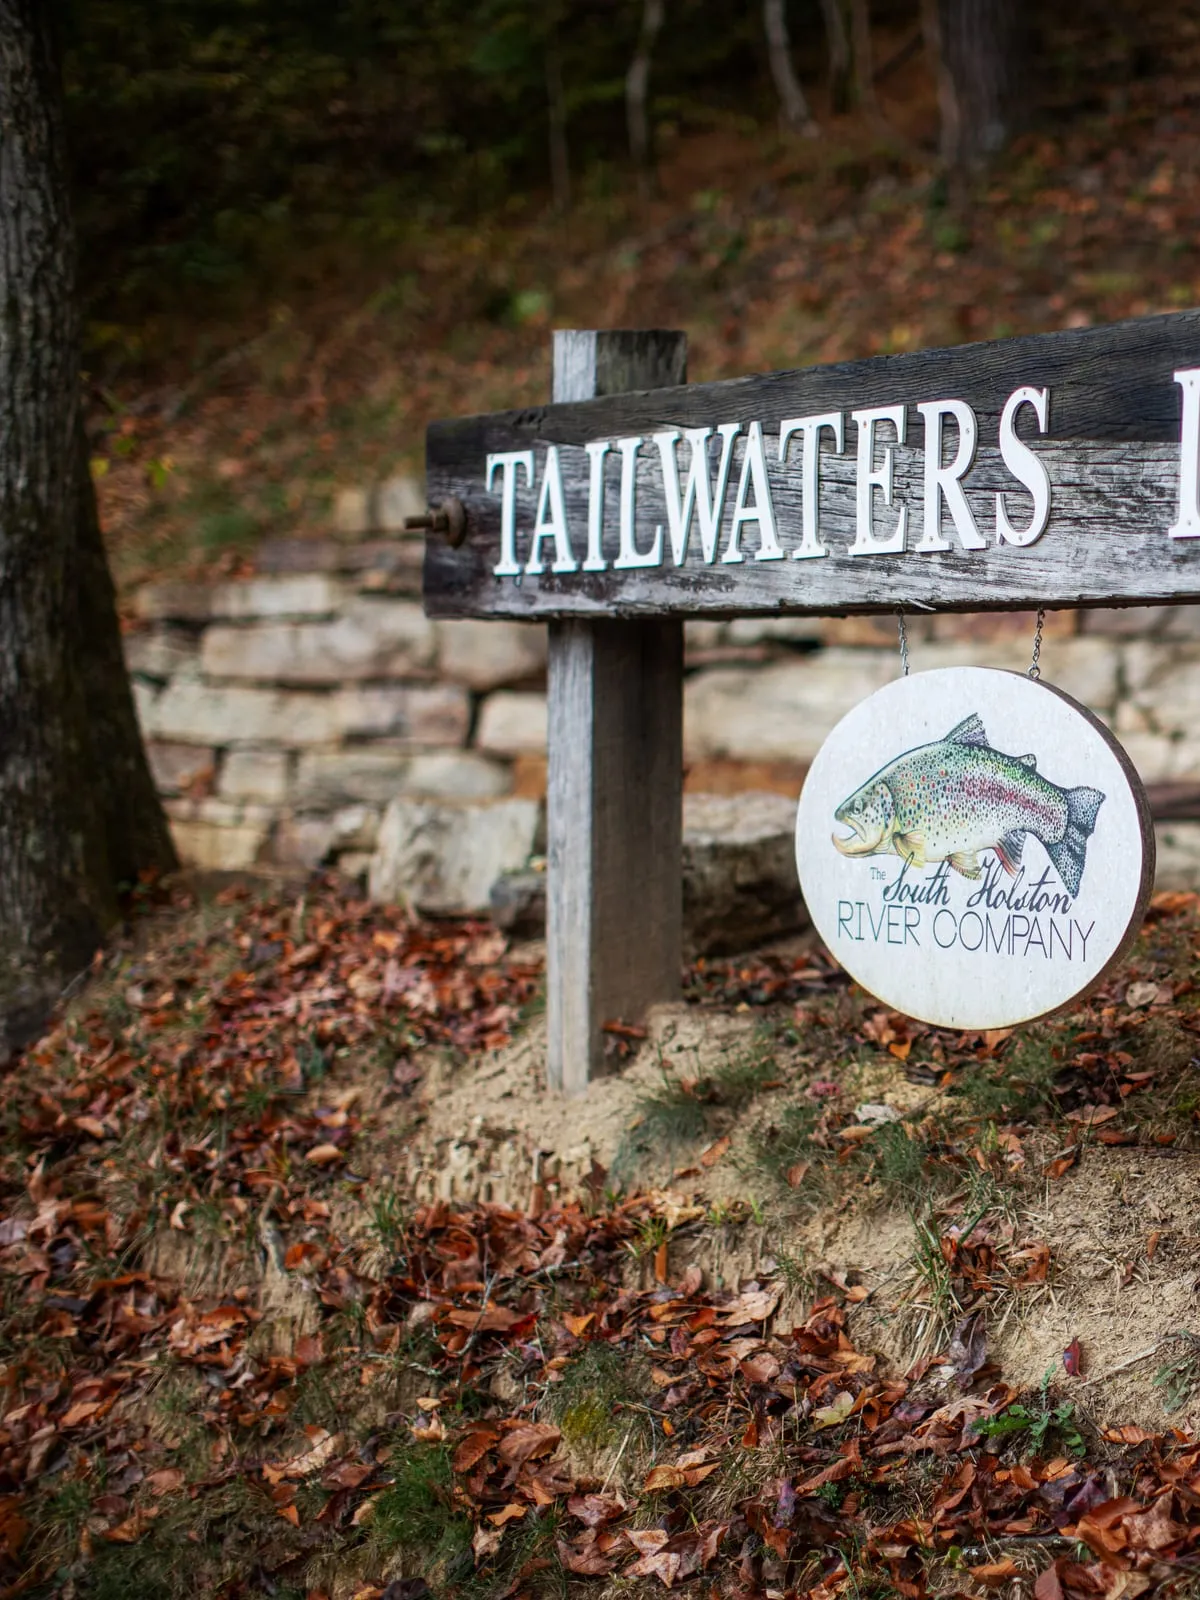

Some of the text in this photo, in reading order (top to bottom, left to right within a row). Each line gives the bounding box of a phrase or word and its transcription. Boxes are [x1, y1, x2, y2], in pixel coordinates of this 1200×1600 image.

[485, 385, 1052, 577] TAILWATERS
[870, 851, 1074, 915] The South Holston
[838, 901, 1096, 962] RIVER COMPANY
